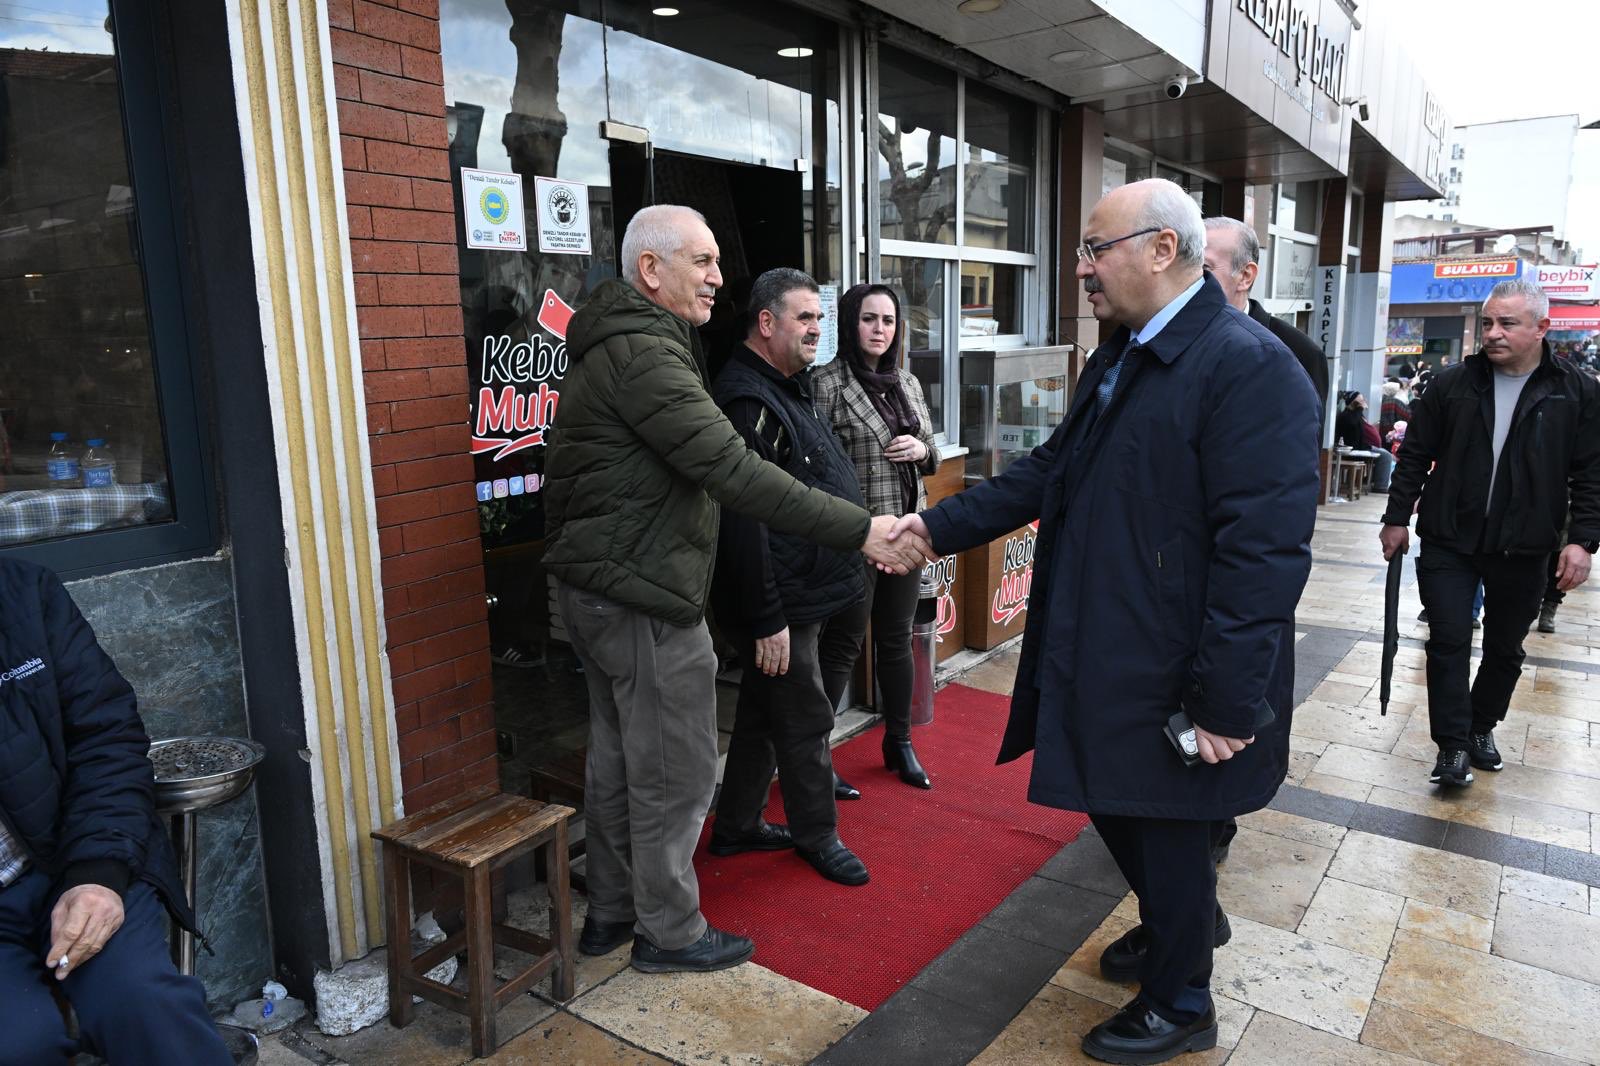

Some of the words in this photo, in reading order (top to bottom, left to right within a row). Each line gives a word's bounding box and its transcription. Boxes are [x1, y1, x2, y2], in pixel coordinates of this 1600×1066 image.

[1310, 24, 1345, 107] BAKİ
[1441, 264, 1509, 275] SULAYICI
[1539, 269, 1593, 284] beybix
[1, 657, 43, 681] Columbia
